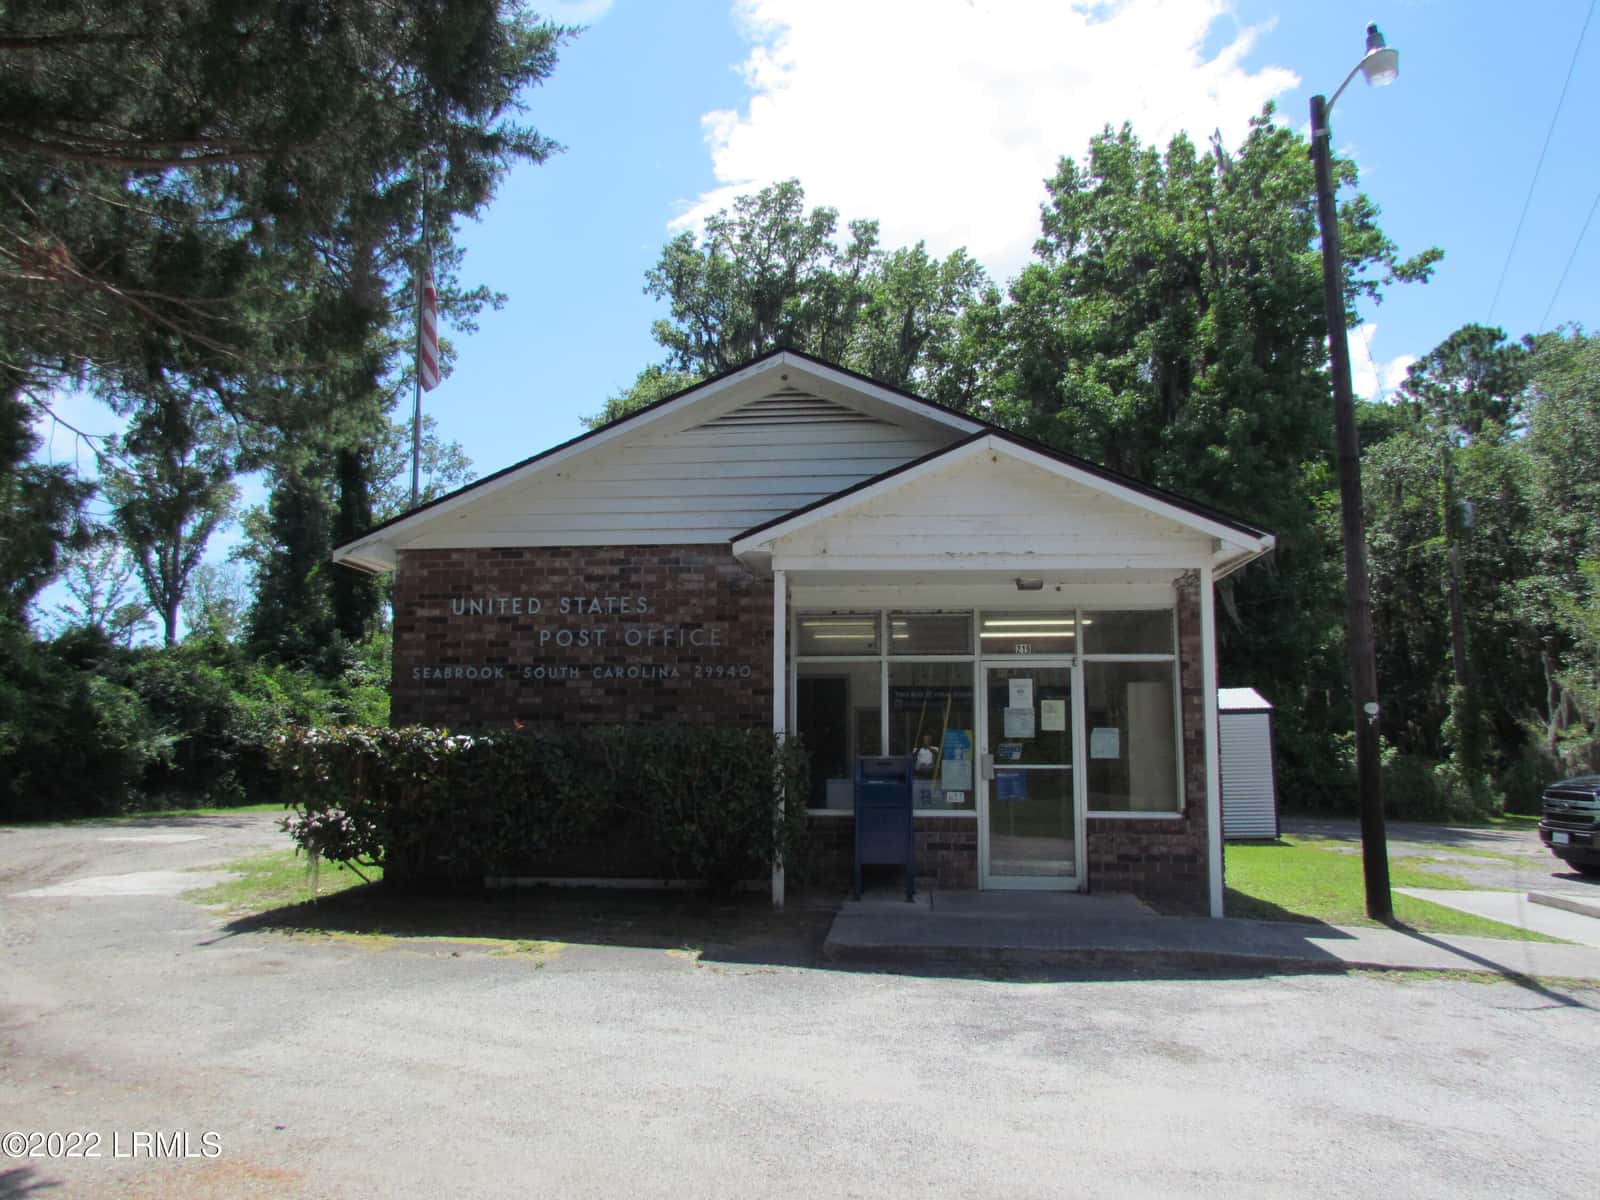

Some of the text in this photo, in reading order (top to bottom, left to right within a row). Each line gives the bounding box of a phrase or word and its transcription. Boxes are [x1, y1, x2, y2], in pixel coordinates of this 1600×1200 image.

[451, 597, 649, 615] UNITED STATES
[539, 629, 722, 647] POST OFFICE
[412, 666, 752, 679] SEABROOK SOUTH CAROLINA 29940
